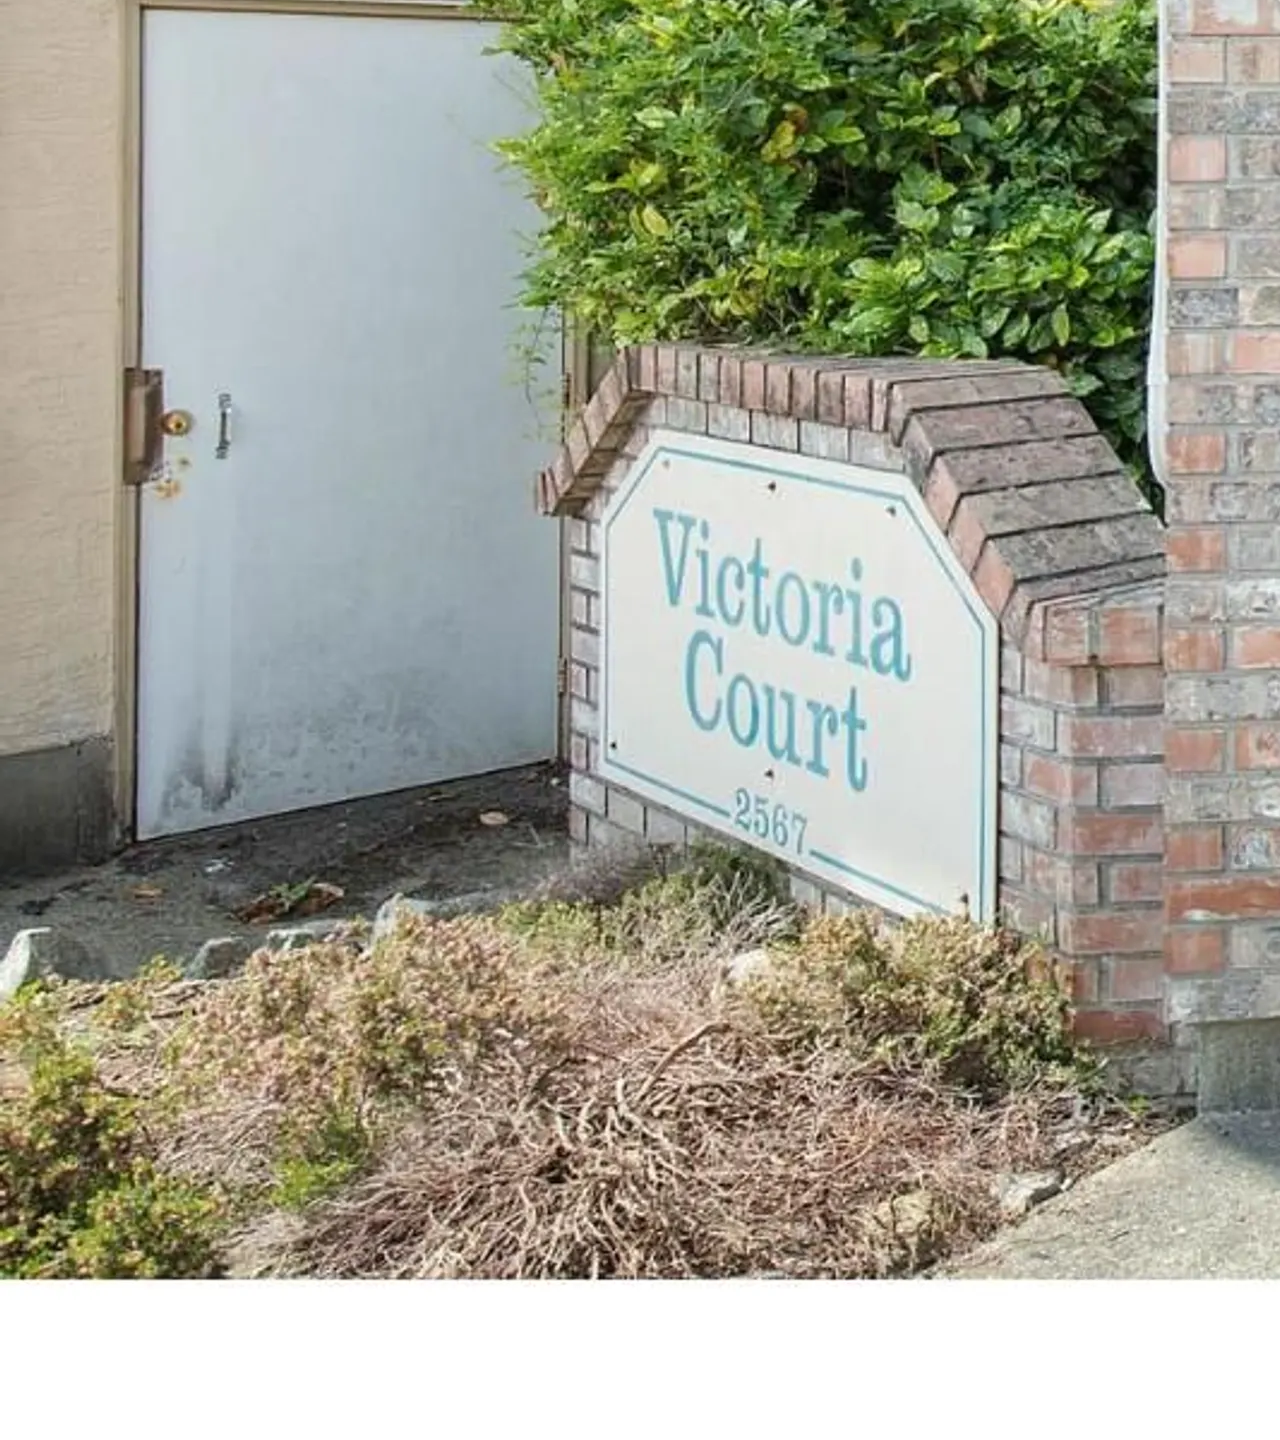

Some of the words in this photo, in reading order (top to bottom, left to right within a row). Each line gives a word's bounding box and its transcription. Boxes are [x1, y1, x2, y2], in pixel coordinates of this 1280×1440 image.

[654, 509, 911, 681] Victoria
[686, 631, 867, 792] Court
[734, 788, 808, 854] 2567
